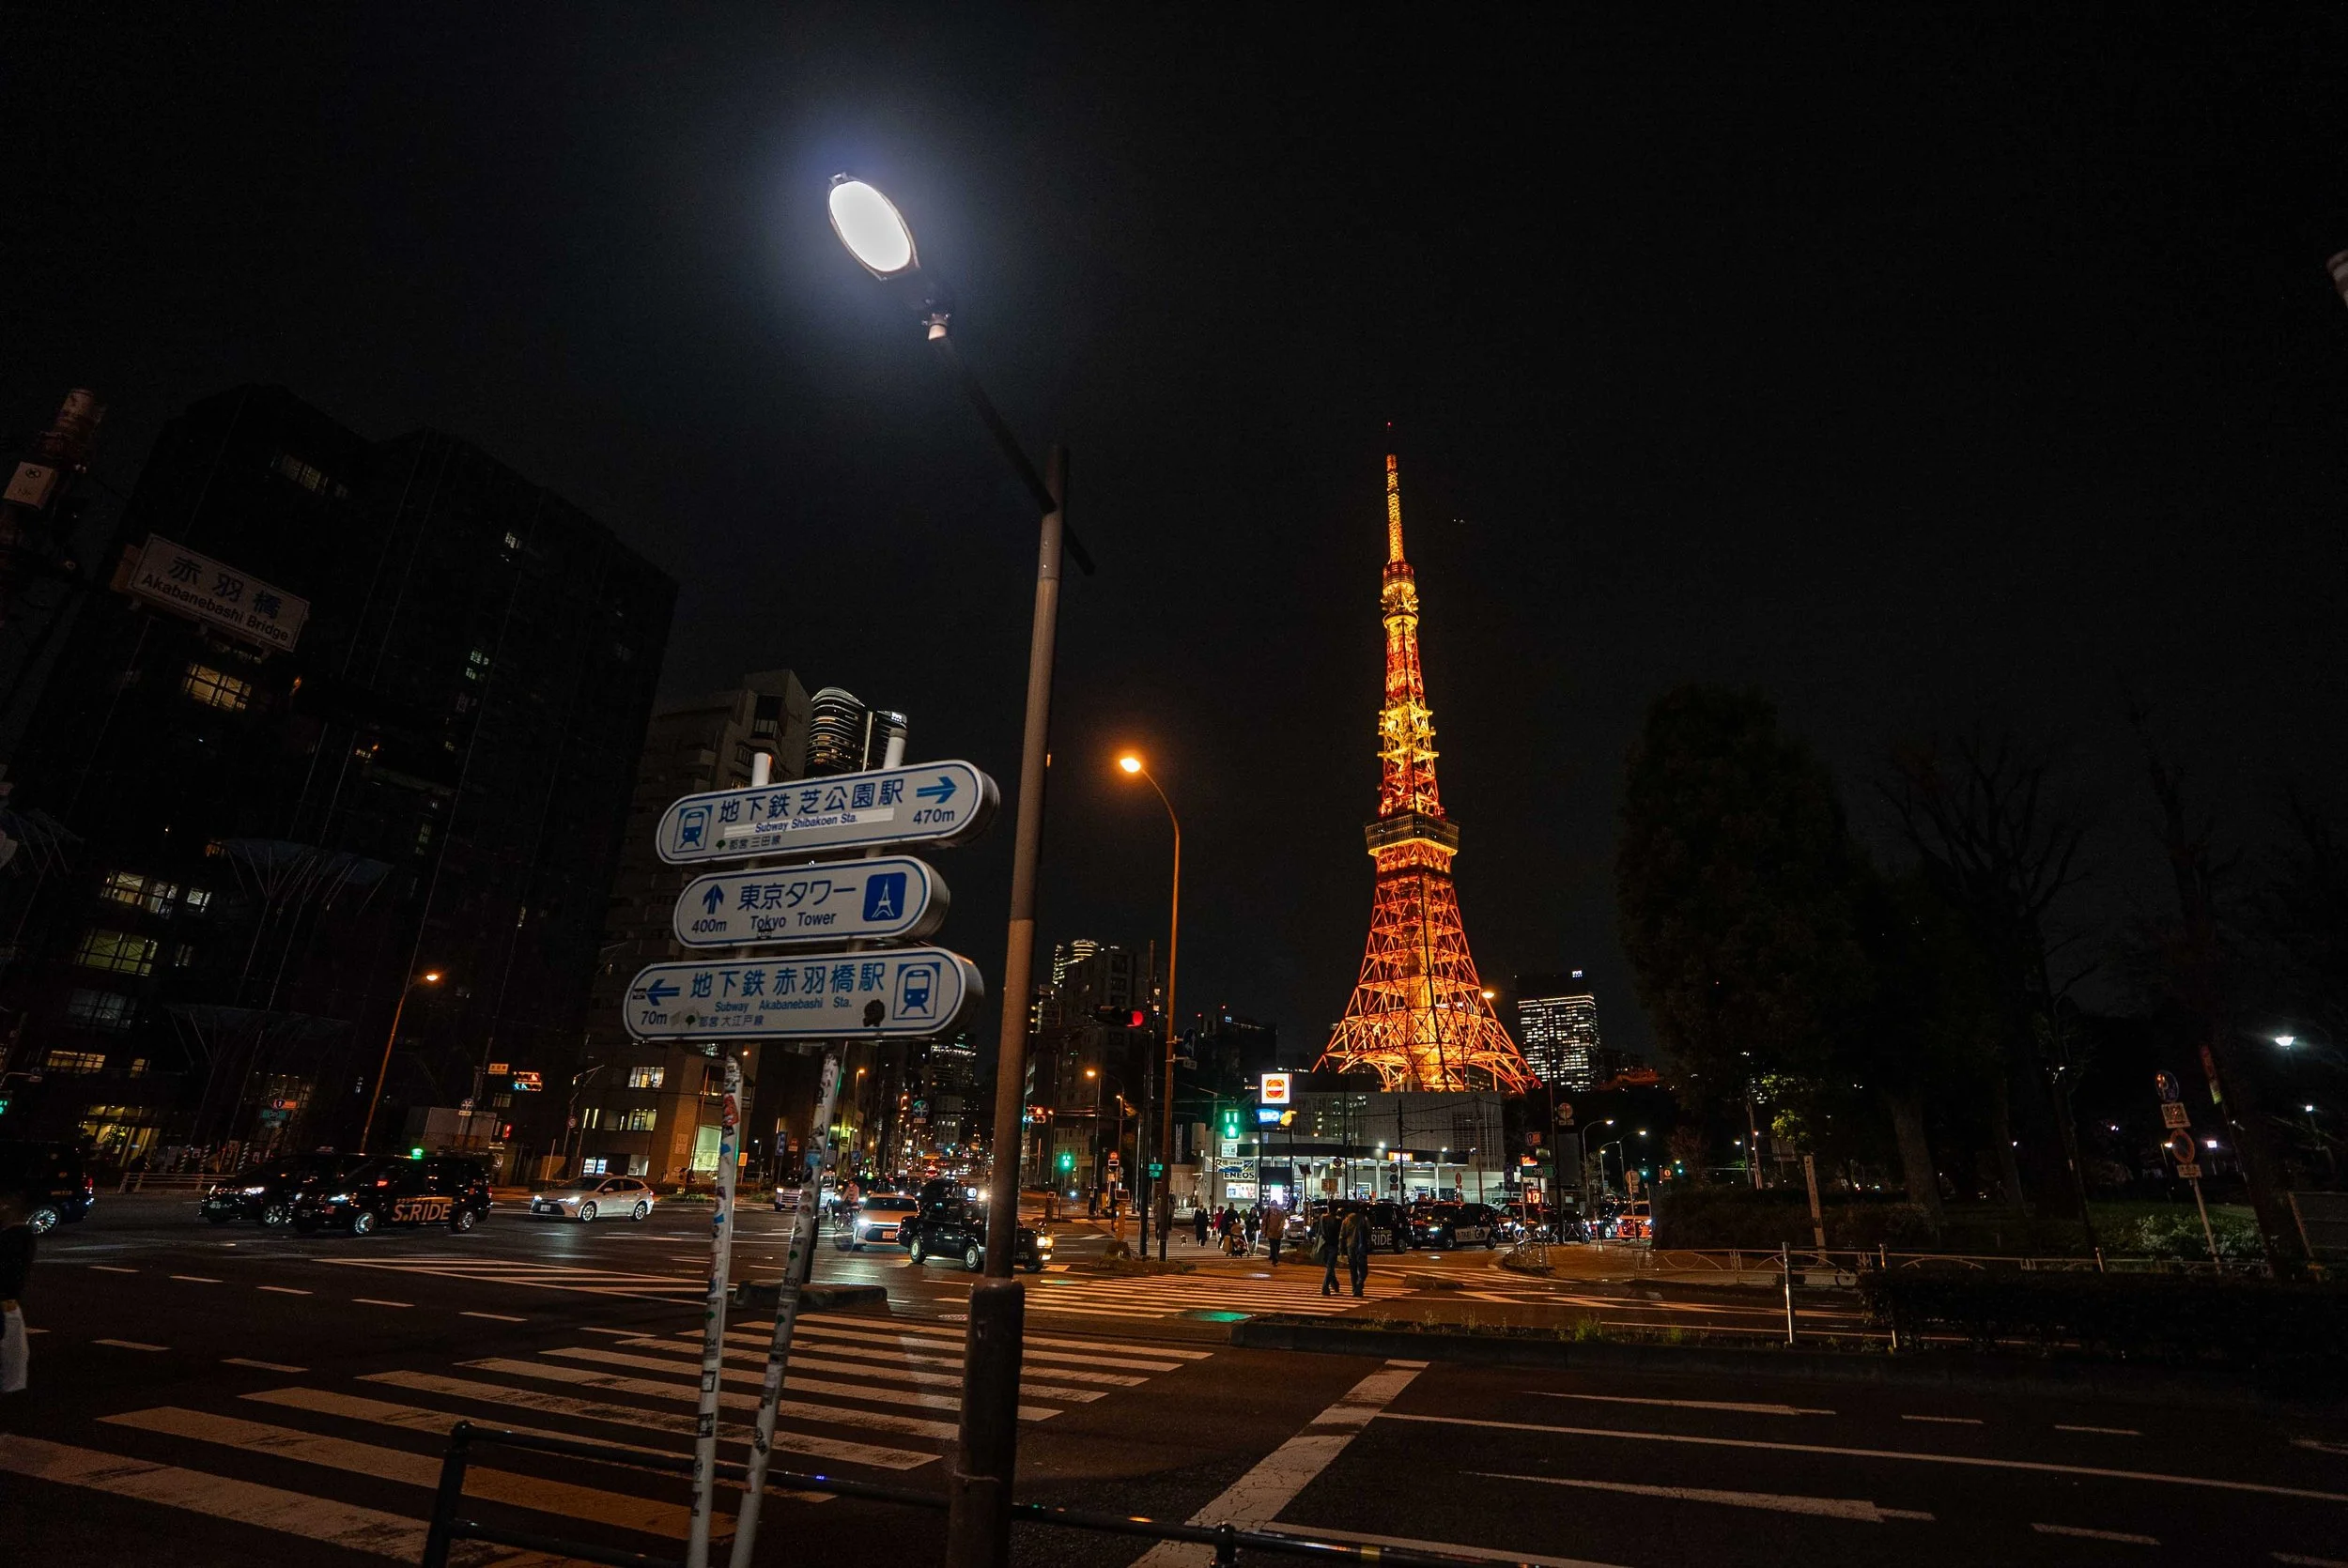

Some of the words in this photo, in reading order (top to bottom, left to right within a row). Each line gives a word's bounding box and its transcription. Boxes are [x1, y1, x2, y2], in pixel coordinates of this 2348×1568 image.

[168, 556, 282, 619] 赤羽橋
[142, 574, 243, 623] Akabanebashi
[247, 615, 288, 641] Bridge
[718, 793, 791, 823] 地下鉄
[797, 778, 904, 815] 芝公園駅
[755, 821, 788, 833] Subway
[792, 814, 838, 828] Shibakoen
[841, 813, 857, 823] Sta.
[913, 808, 955, 824] 470m
[737, 880, 857, 911] 東京タワー
[691, 918, 727, 933] 400m
[751, 915, 786, 930] Tokyo
[797, 912, 837, 927] Tower
[690, 970, 765, 998] 地下鉄
[773, 962, 886, 996] 赤羽橋駅
[715, 1001, 749, 1013] Subway
[759, 997, 824, 1010] Akabanebashi
[833, 996, 852, 1008] Sta.
[641, 1011, 667, 1025] 70m
[391, 1203, 452, 1222] S.RIDE
